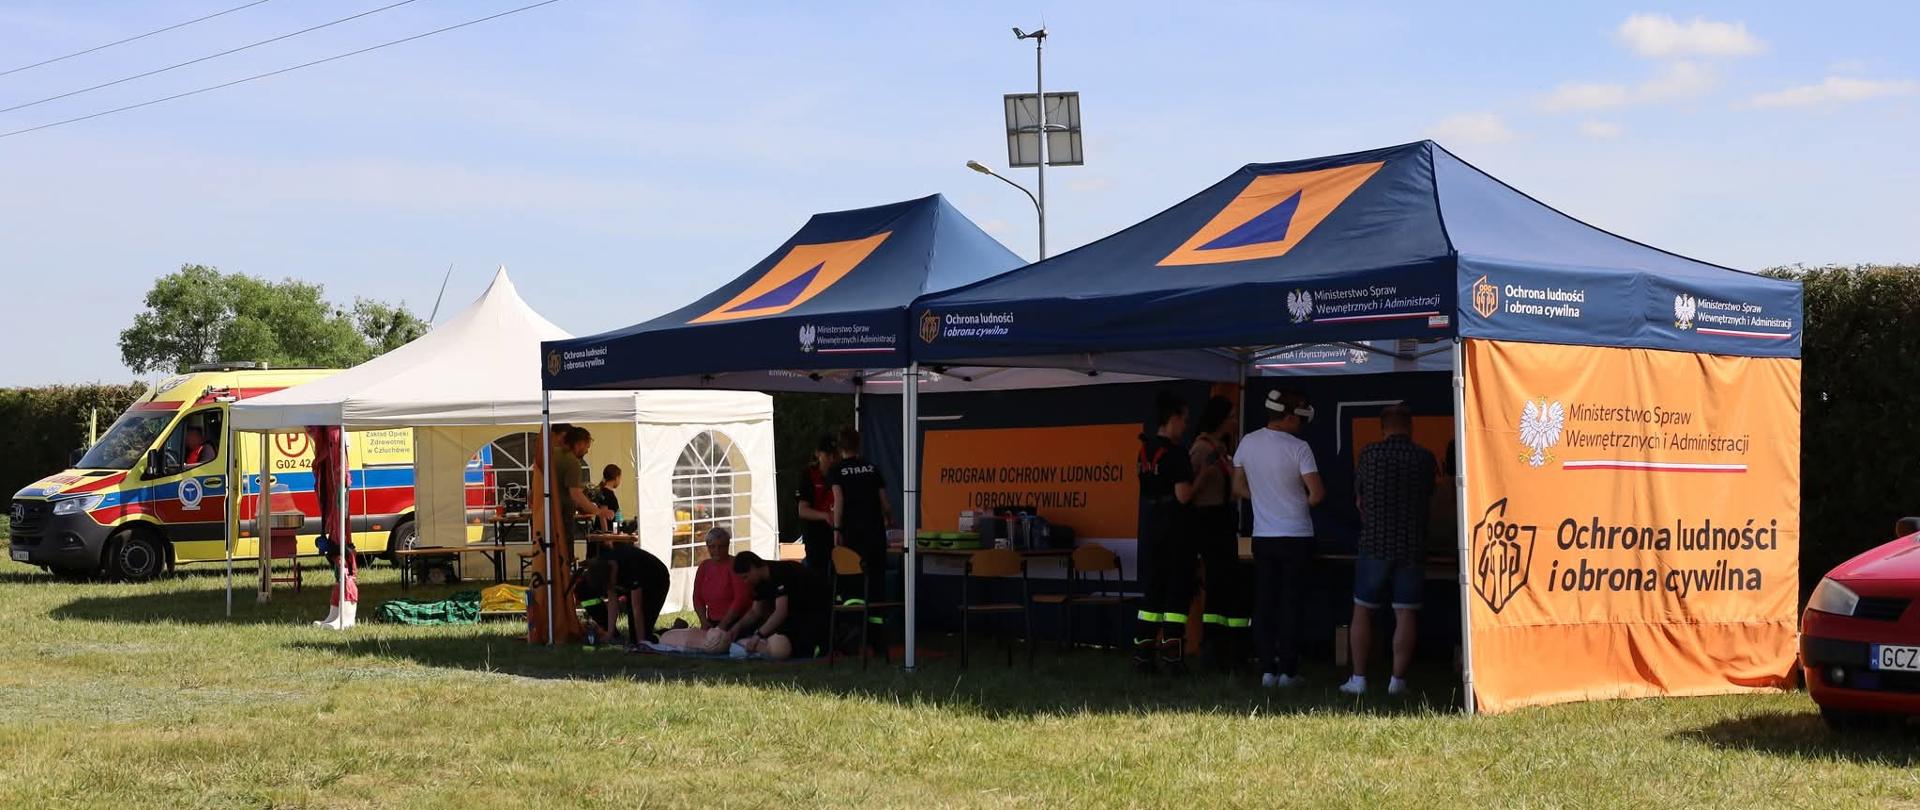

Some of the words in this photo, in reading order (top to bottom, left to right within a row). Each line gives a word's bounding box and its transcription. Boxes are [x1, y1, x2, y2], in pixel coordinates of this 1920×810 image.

[1314, 289, 1369, 300] Ministerstwo
[1369, 285, 1397, 297] Spraw
[1505, 284, 1546, 300] Ochrona
[1547, 287, 1585, 302] ludności
[1316, 299, 1378, 314] Wewnętrznych
[1385, 293, 1441, 308] Administracji
[1505, 300, 1509, 313] i
[1510, 301, 1543, 315] obrona
[1544, 304, 1580, 318] cywilna
[1698, 299, 1741, 312] Ministerstwo
[1741, 303, 1762, 313] Spraw
[945, 314, 980, 325] Ochrona
[980, 312, 1014, 324] ludności
[1751, 316, 1793, 329] Administracji
[947, 327, 976, 337] obrona
[975, 325, 1009, 337] cywilna
[1569, 403, 1652, 424] Ministerstwo
[1653, 406, 1692, 426] Spraw
[1566, 429, 1660, 451] Wewnętrznych
[1662, 433, 1669, 448] i
[1670, 433, 1749, 455] Administracji
[276, 459, 296, 469] G02
[299, 458, 314, 468] 42
[941, 468, 996, 483] PROGRAM
[1000, 467, 1057, 482] OCHRONY
[1060, 462, 1124, 482] LUDNOŚCI
[975, 492, 1022, 507] OBRONY
[1025, 491, 1087, 508] CYWILNEJ
[1556, 516, 1671, 550] Ochrona
[1677, 518, 1777, 550] ludności
[1548, 560, 1558, 592] i
[1561, 559, 1657, 592] obrona
[1665, 560, 1762, 598] cywilna
[1882, 648, 1918, 668] GCZ
